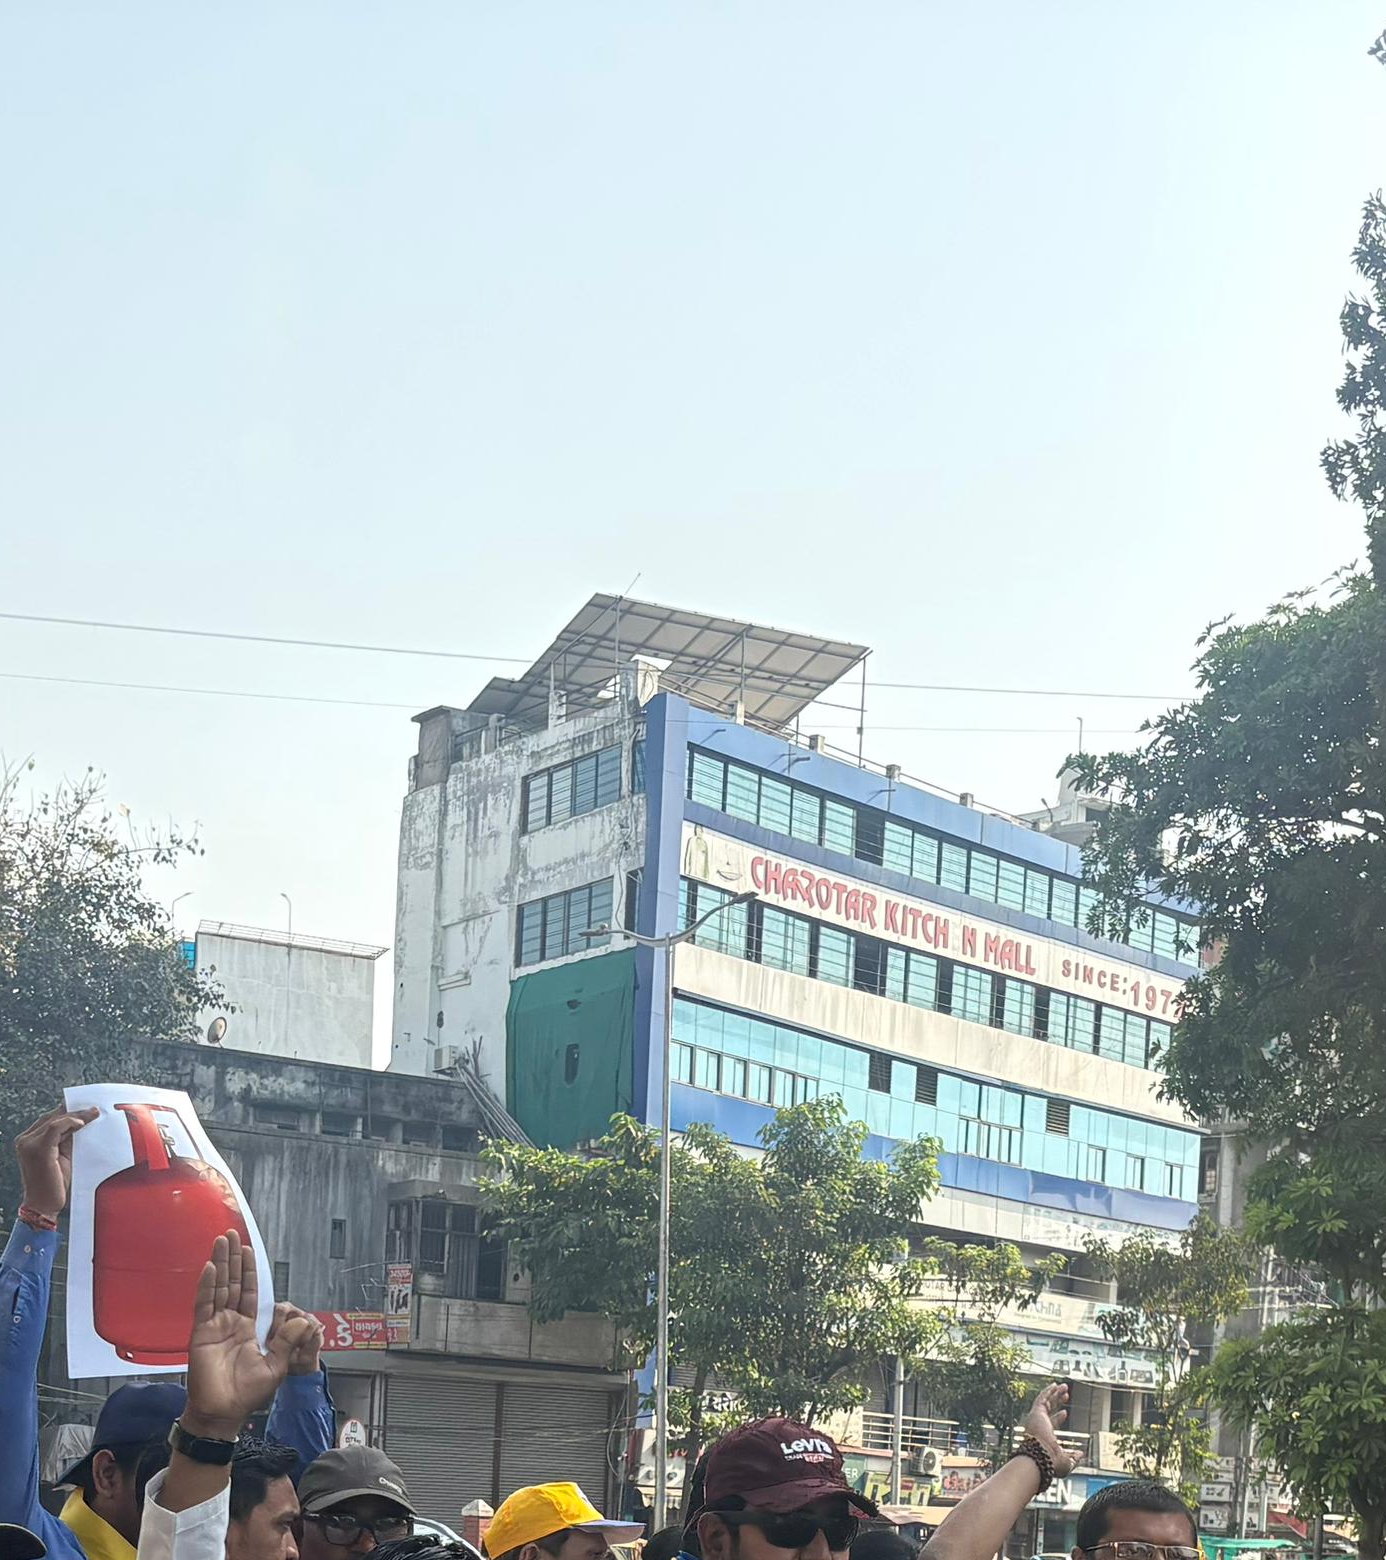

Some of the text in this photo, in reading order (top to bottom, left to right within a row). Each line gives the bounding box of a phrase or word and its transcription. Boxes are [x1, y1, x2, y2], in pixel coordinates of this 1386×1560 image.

[751, 856, 878, 929] CHAROTAR
[984, 931, 1036, 976] MALL
[844, 1467, 859, 1479] ER
